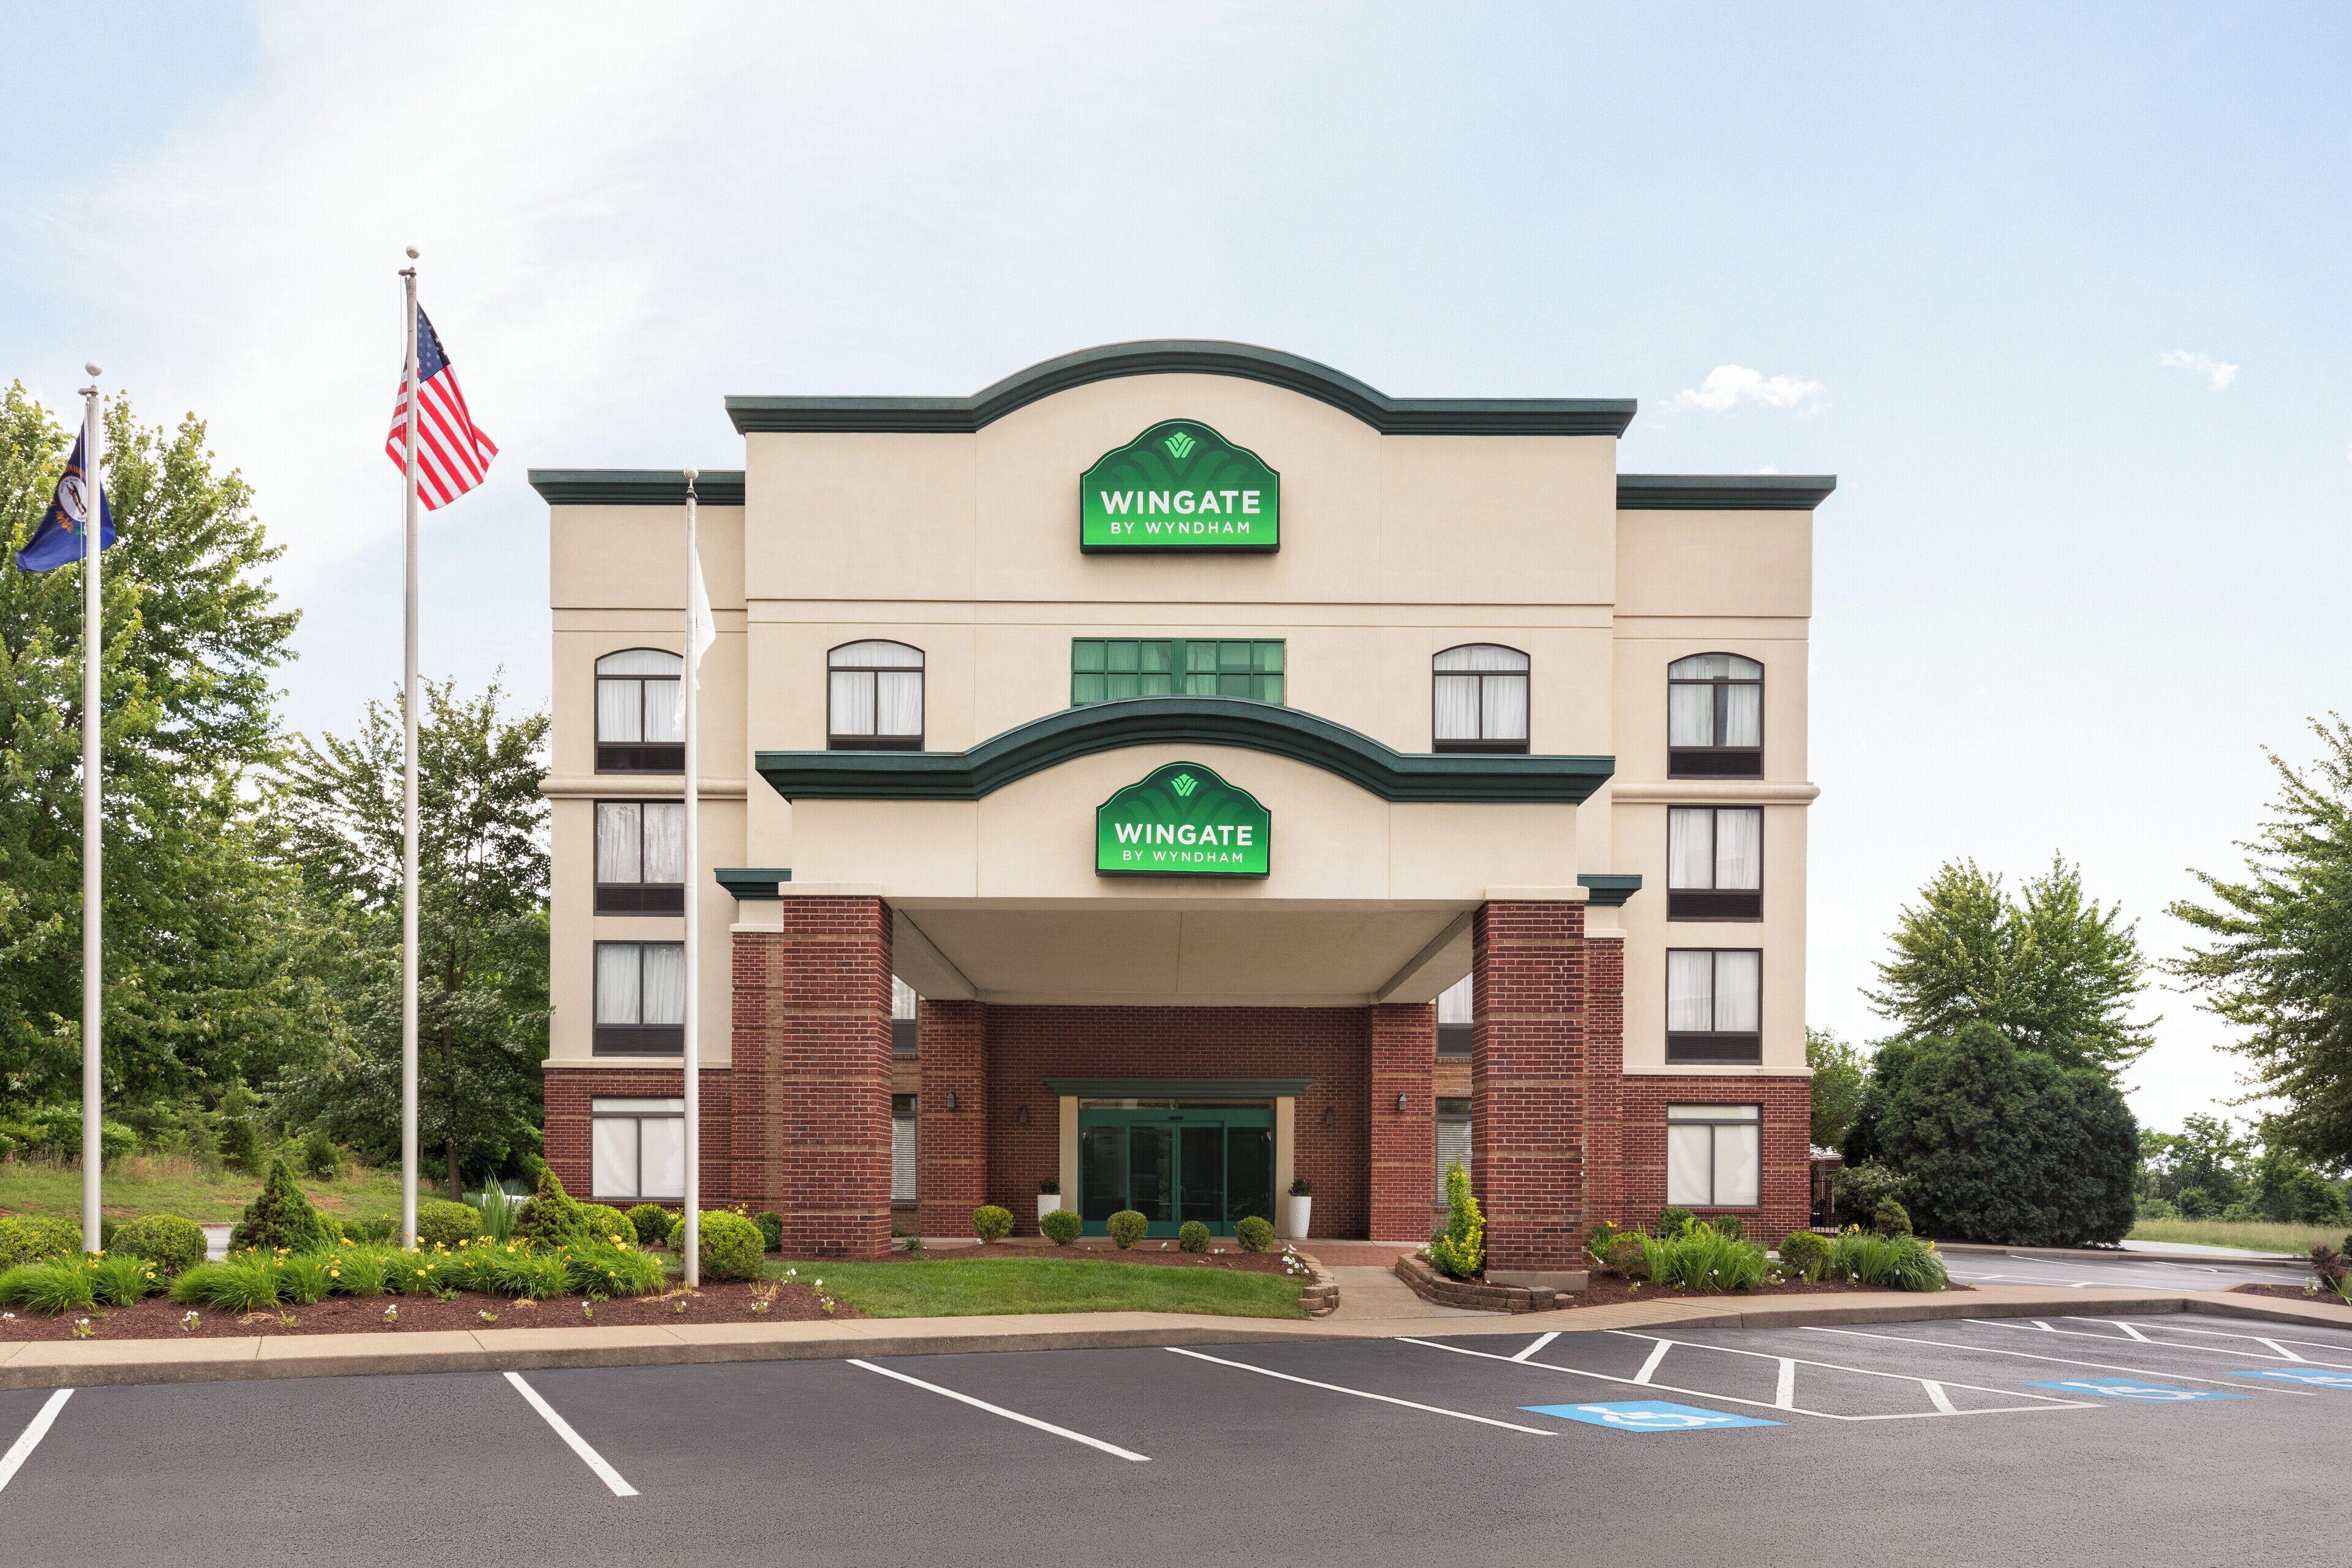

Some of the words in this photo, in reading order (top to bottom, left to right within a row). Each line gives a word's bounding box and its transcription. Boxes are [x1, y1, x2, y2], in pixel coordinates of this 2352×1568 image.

[1101, 491, 1260, 514] WINGATE
[1111, 522, 1134, 534] BY
[1145, 522, 1250, 534] WYNDHAM
[1115, 823, 1253, 846] WINGATE
[1123, 850, 1143, 861] BY
[1153, 851, 1243, 863] WYNDHAM
